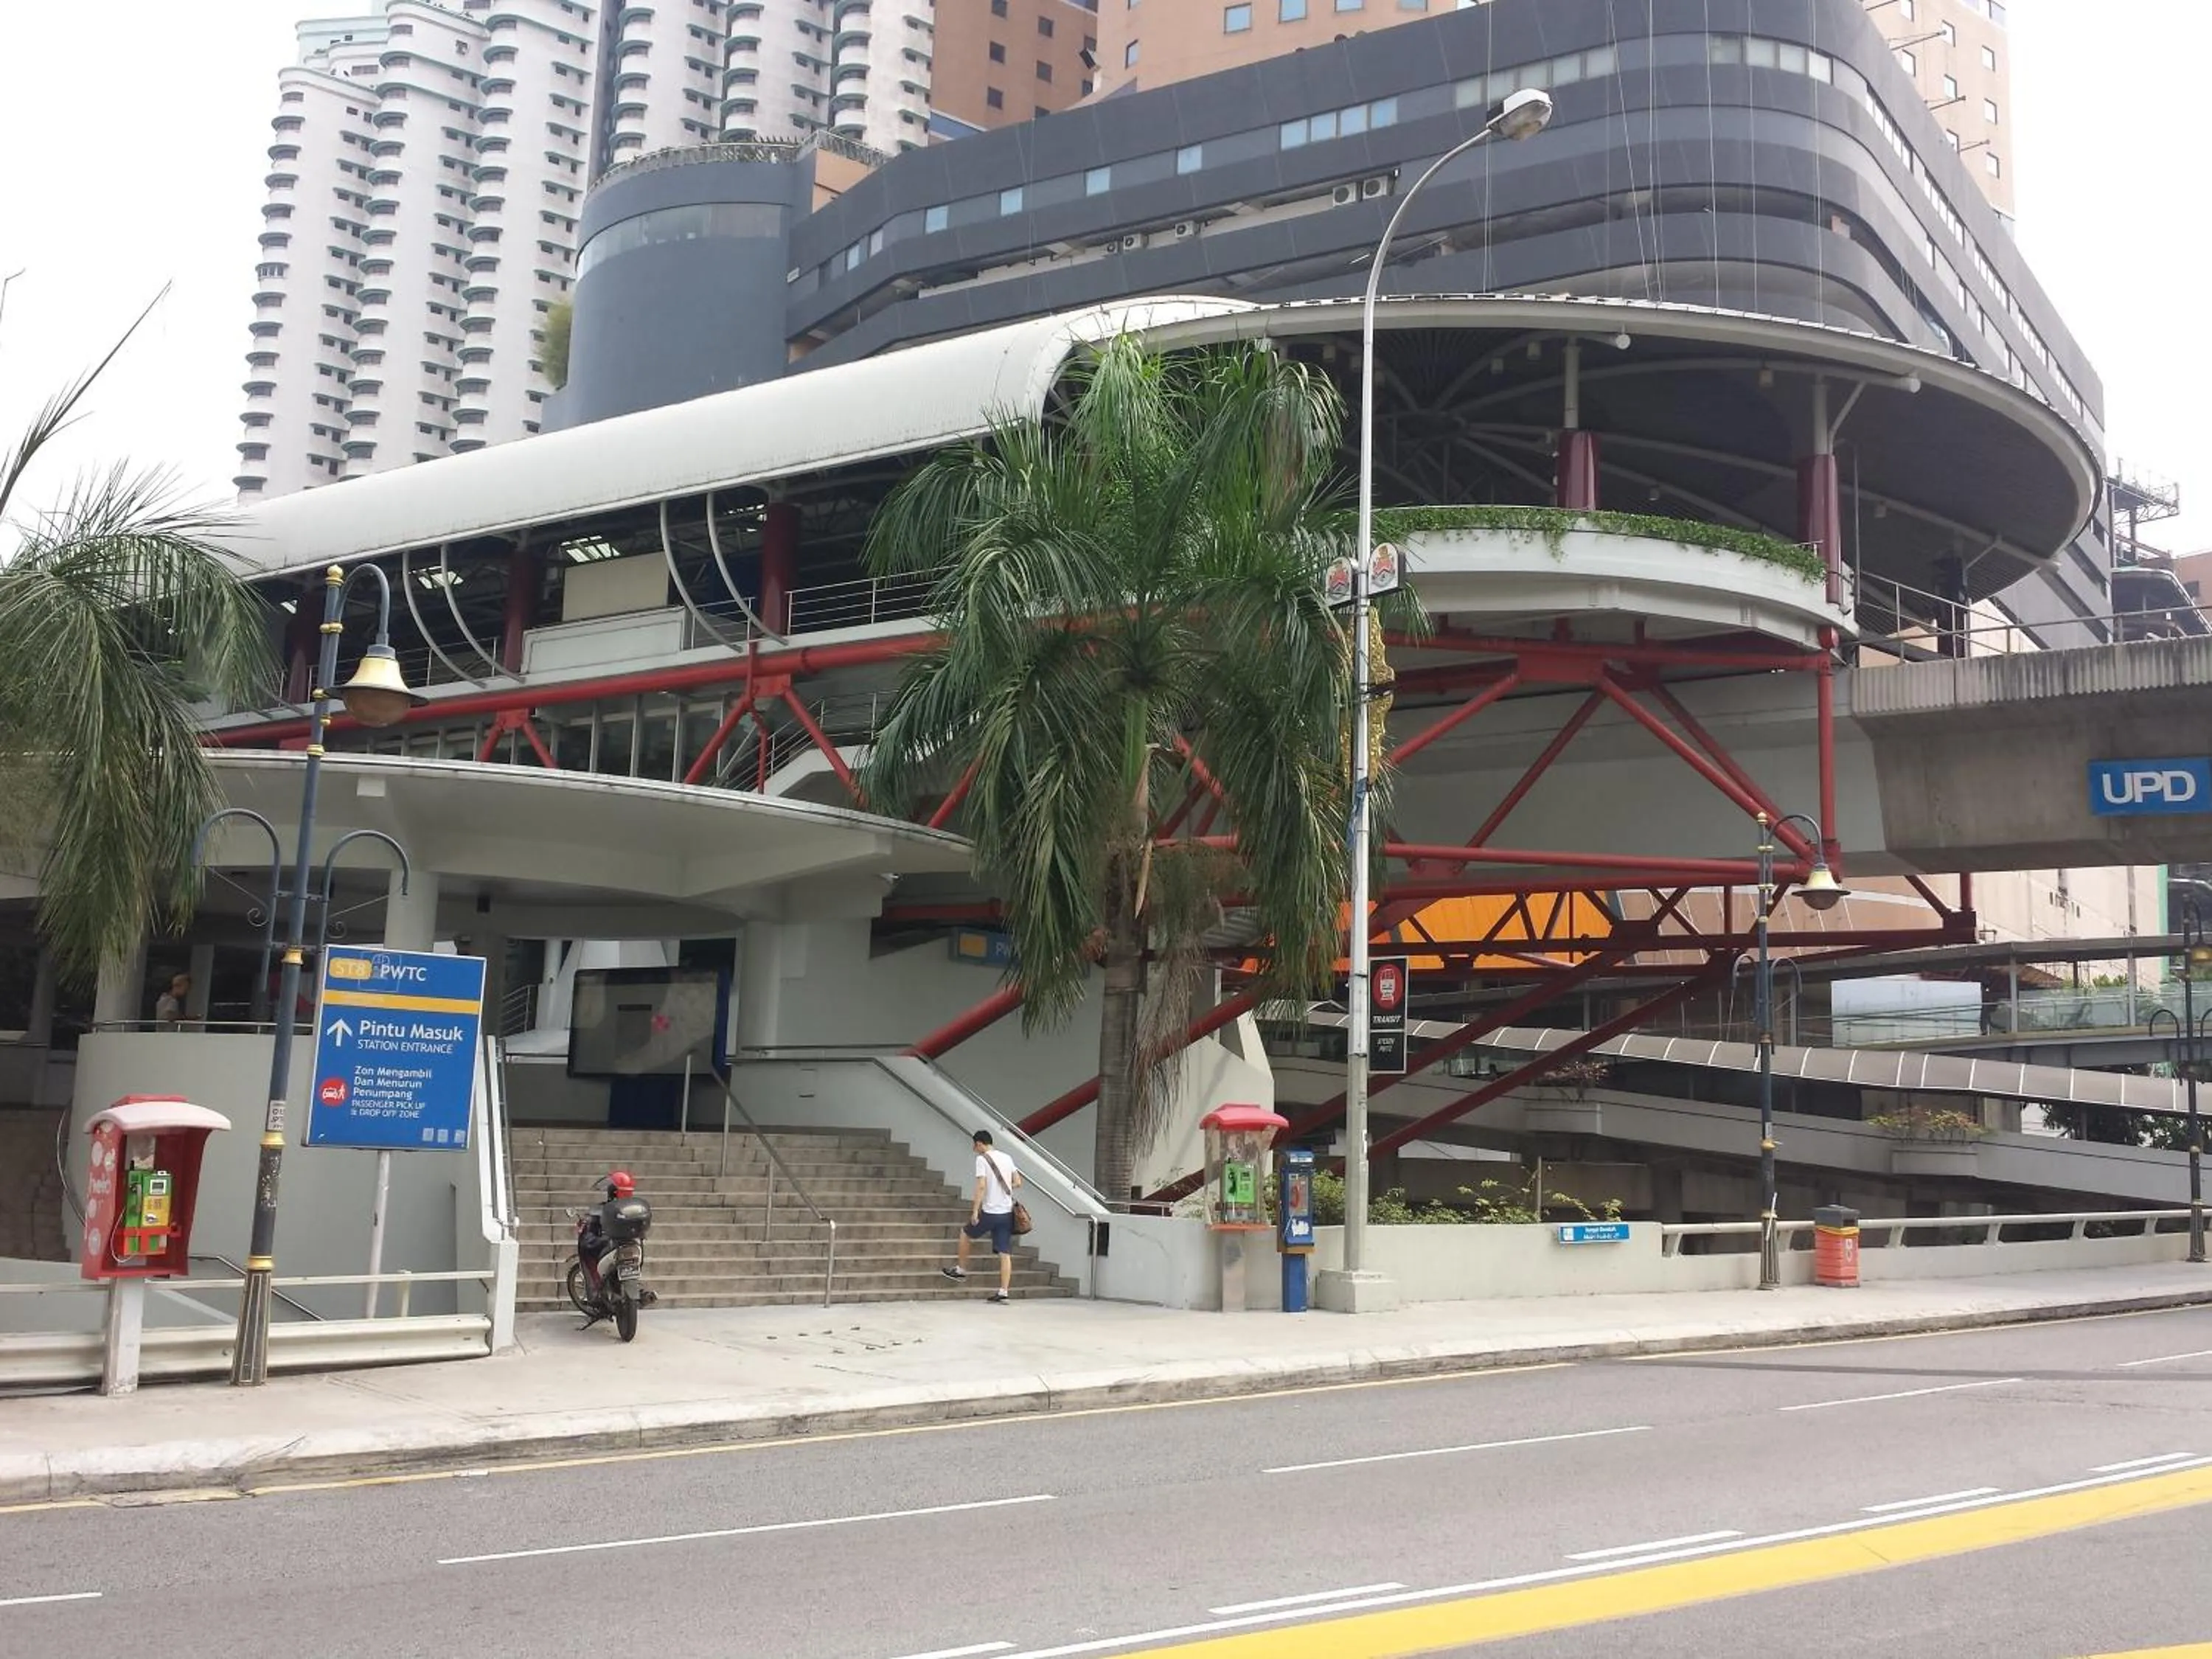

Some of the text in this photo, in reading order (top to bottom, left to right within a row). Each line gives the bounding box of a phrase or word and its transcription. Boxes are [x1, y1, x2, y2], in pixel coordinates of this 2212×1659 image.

[2102, 771, 2197, 804] UPD
[335, 960, 428, 982] ST8 PWTC
[1372, 1015, 1401, 1023] TRANSIT
[359, 1020, 464, 1042] Pintu Masuk
[357, 1039, 454, 1054] STATION ENTRANCE
[355, 1065, 432, 1079] Zon Mengambil
[354, 1076, 422, 1088] Dan Menurun
[353, 1086, 413, 1100] Penumpang
[352, 1099, 394, 1107] PASSENGER
[359, 1108, 381, 1117] DROP
[382, 1109, 397, 1117] OFF
[399, 1110, 420, 1119] ZONE
